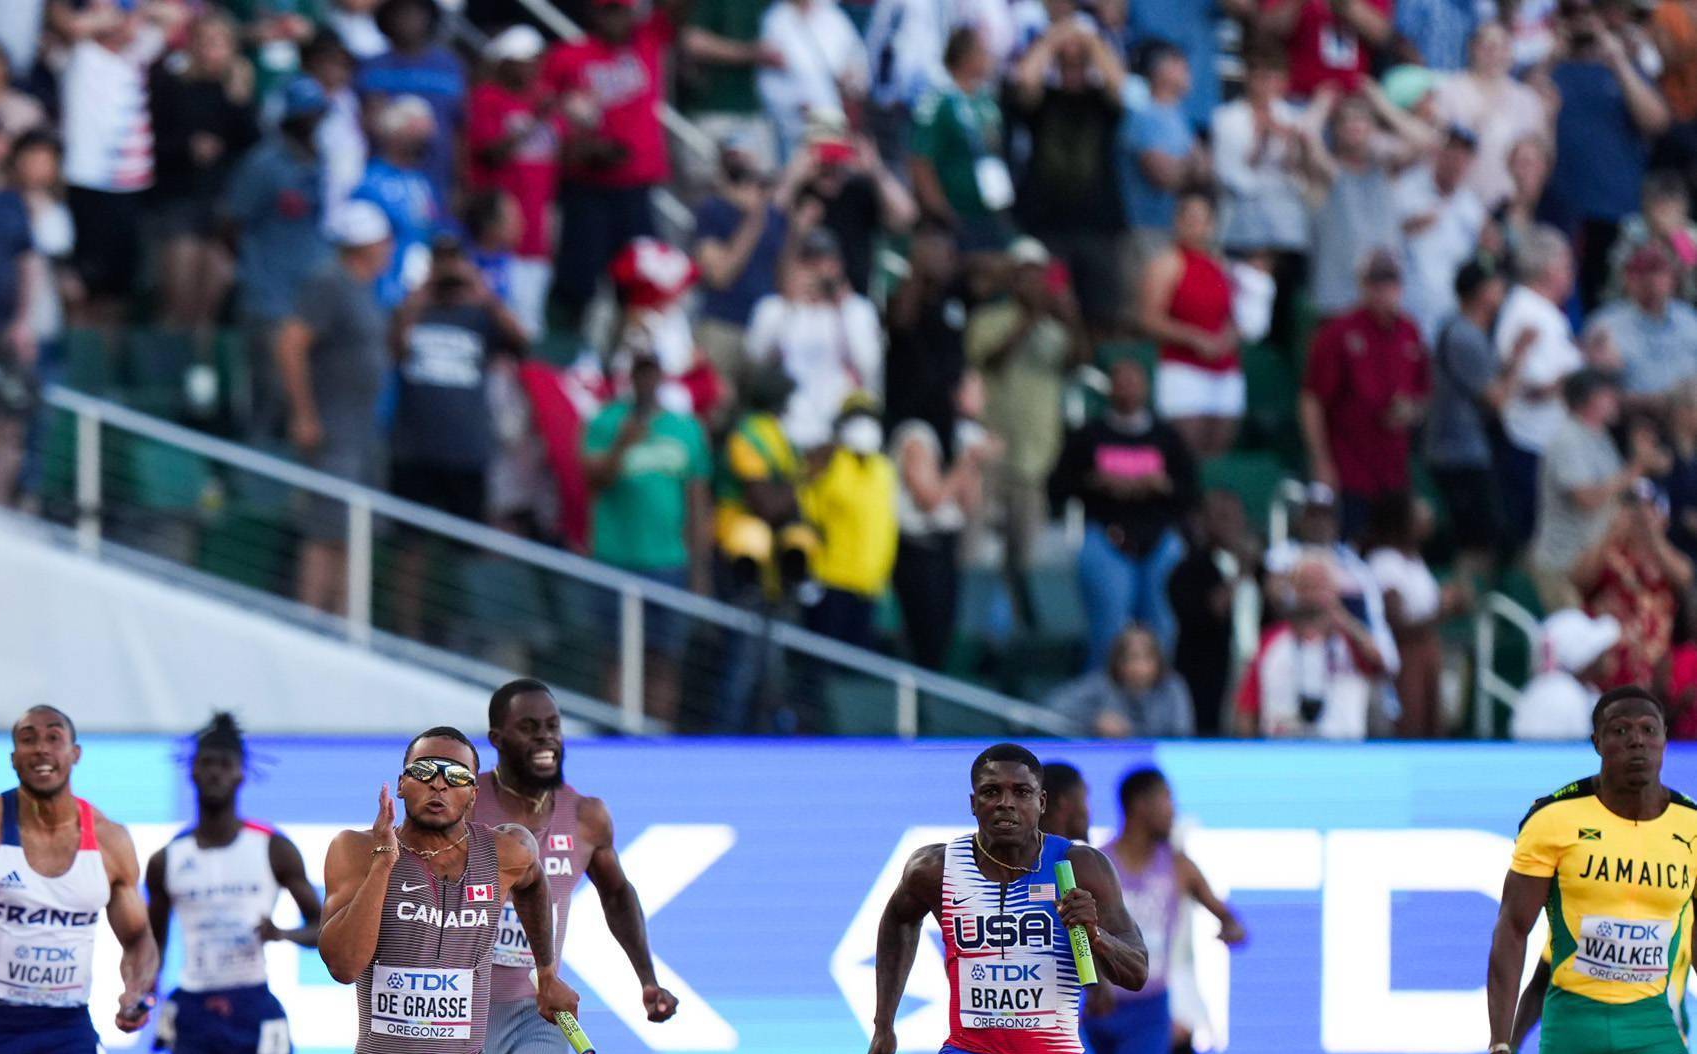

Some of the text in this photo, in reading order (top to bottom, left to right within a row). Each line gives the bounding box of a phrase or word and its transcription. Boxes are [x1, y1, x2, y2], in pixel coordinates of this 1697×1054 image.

[1579, 854, 1690, 890] JAMAICA
[396, 902, 489, 928] CANADA
[954, 910, 1054, 951] USA
[1614, 923, 1660, 941] TDK
[31, 946, 78, 961] TDK
[1584, 937, 1663, 966] WALKER
[8, 961, 78, 984] VICAUT
[404, 974, 459, 991] TDK
[986, 964, 1042, 982] TDK
[1588, 967, 1653, 983] OREGON22
[377, 993, 468, 1018] DE GRASSE
[971, 987, 1044, 1010] BRACY
[387, 1023, 454, 1038] OREGON22
[973, 1017, 1040, 1029] OREGON22
